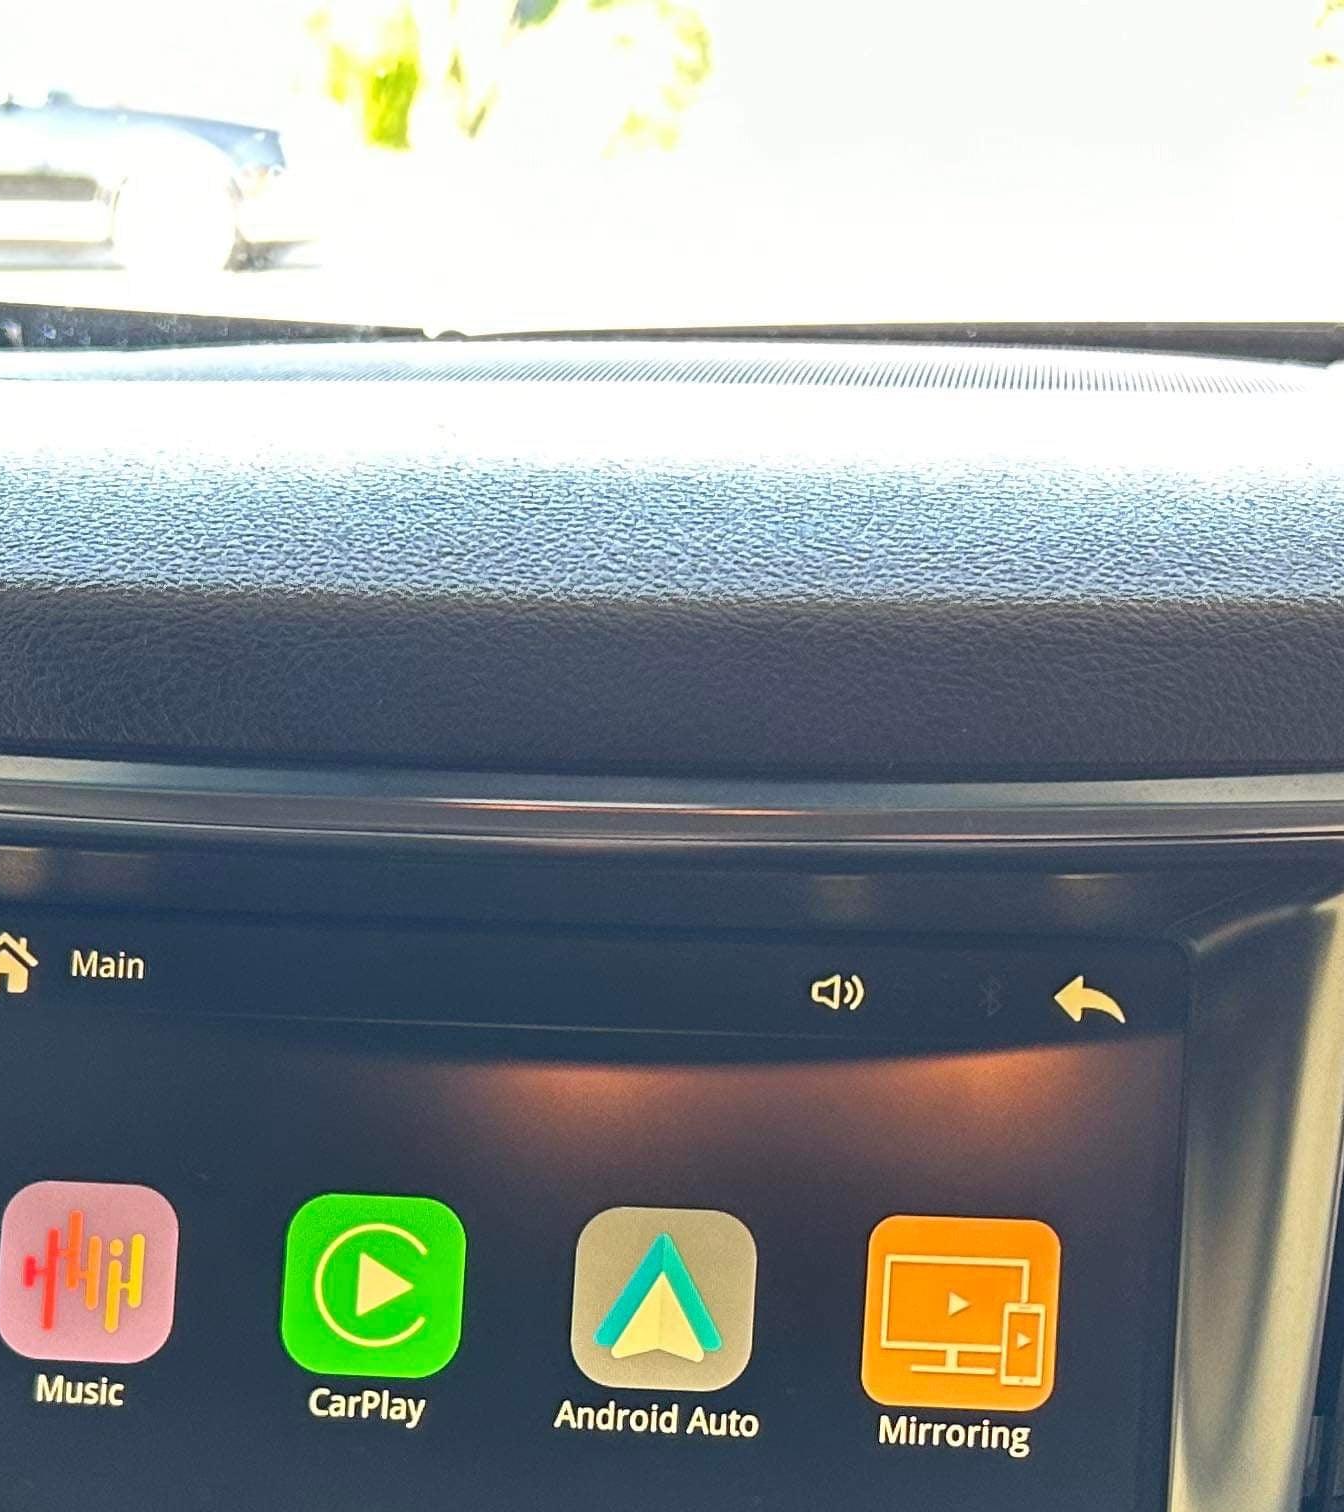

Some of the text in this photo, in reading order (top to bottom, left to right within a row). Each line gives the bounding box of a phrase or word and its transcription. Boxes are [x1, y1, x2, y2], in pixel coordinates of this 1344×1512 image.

[70, 950, 145, 982] Main
[35, 1375, 124, 1408] Music
[309, 1387, 426, 1428] CarPlay
[554, 1399, 759, 1438] Android Auto
[877, 1416, 1031, 1457] Mirroring
